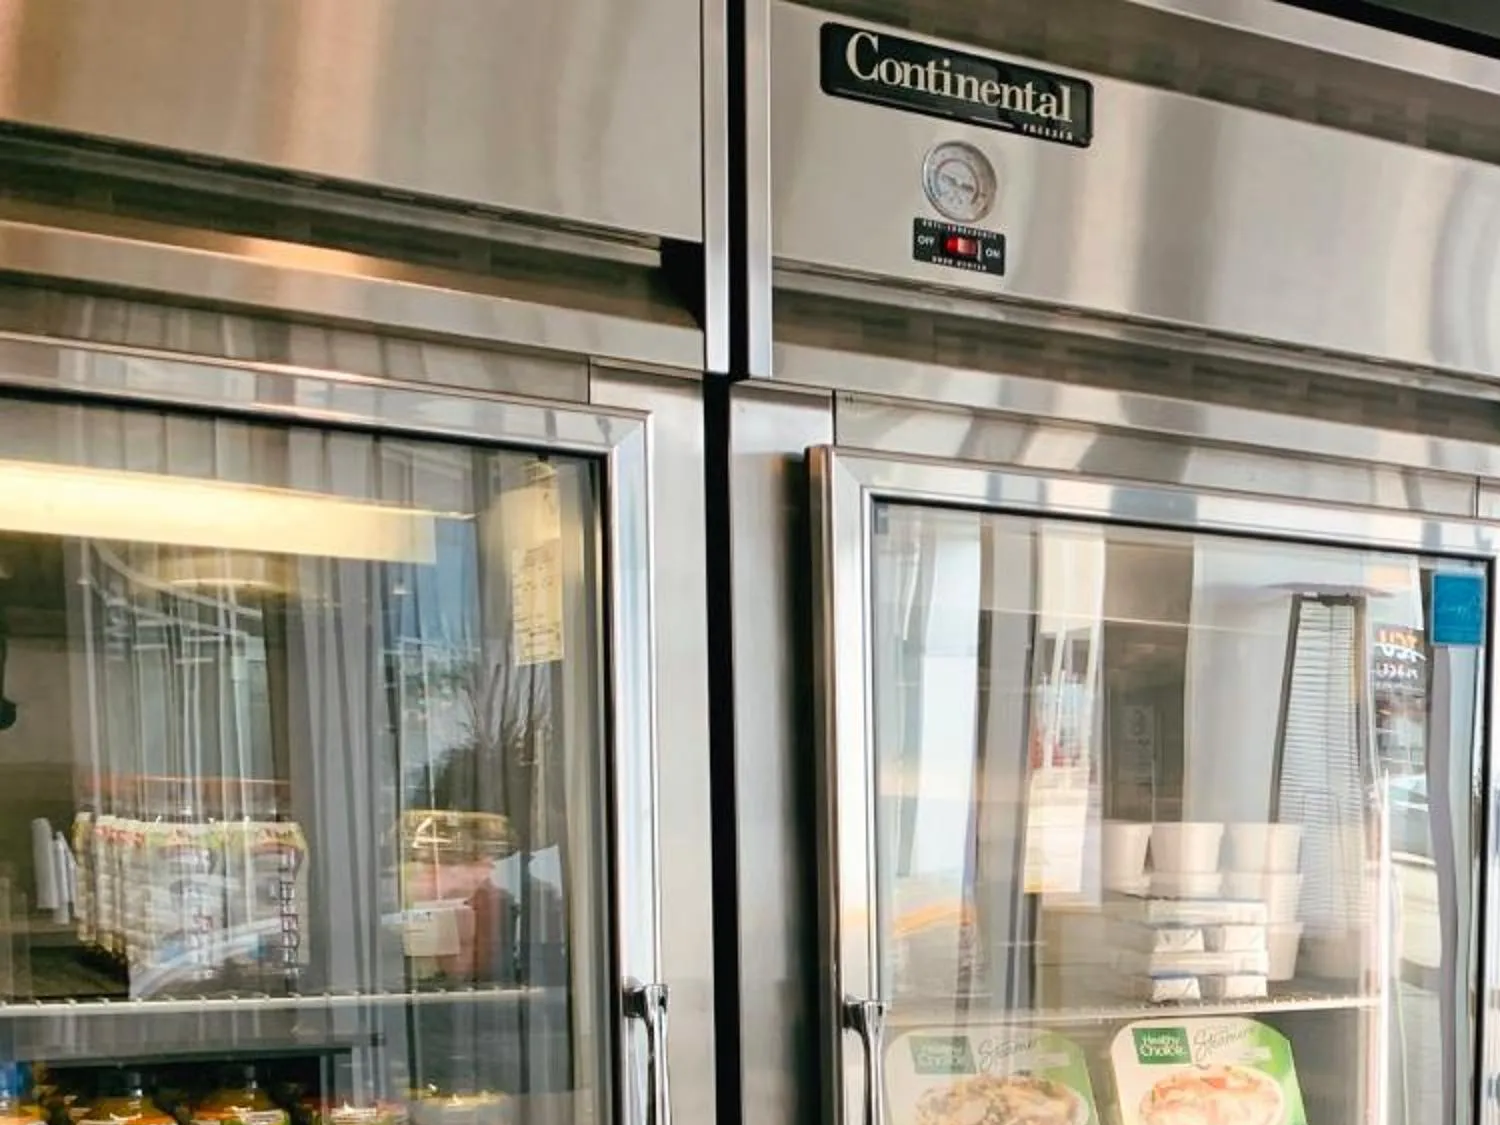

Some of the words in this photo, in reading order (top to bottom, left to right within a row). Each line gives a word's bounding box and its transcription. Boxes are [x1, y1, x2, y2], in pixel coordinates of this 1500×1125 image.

[846, 31, 1073, 122] Continental
[917, 235, 934, 245] OFF
[985, 248, 1000, 257] ON
